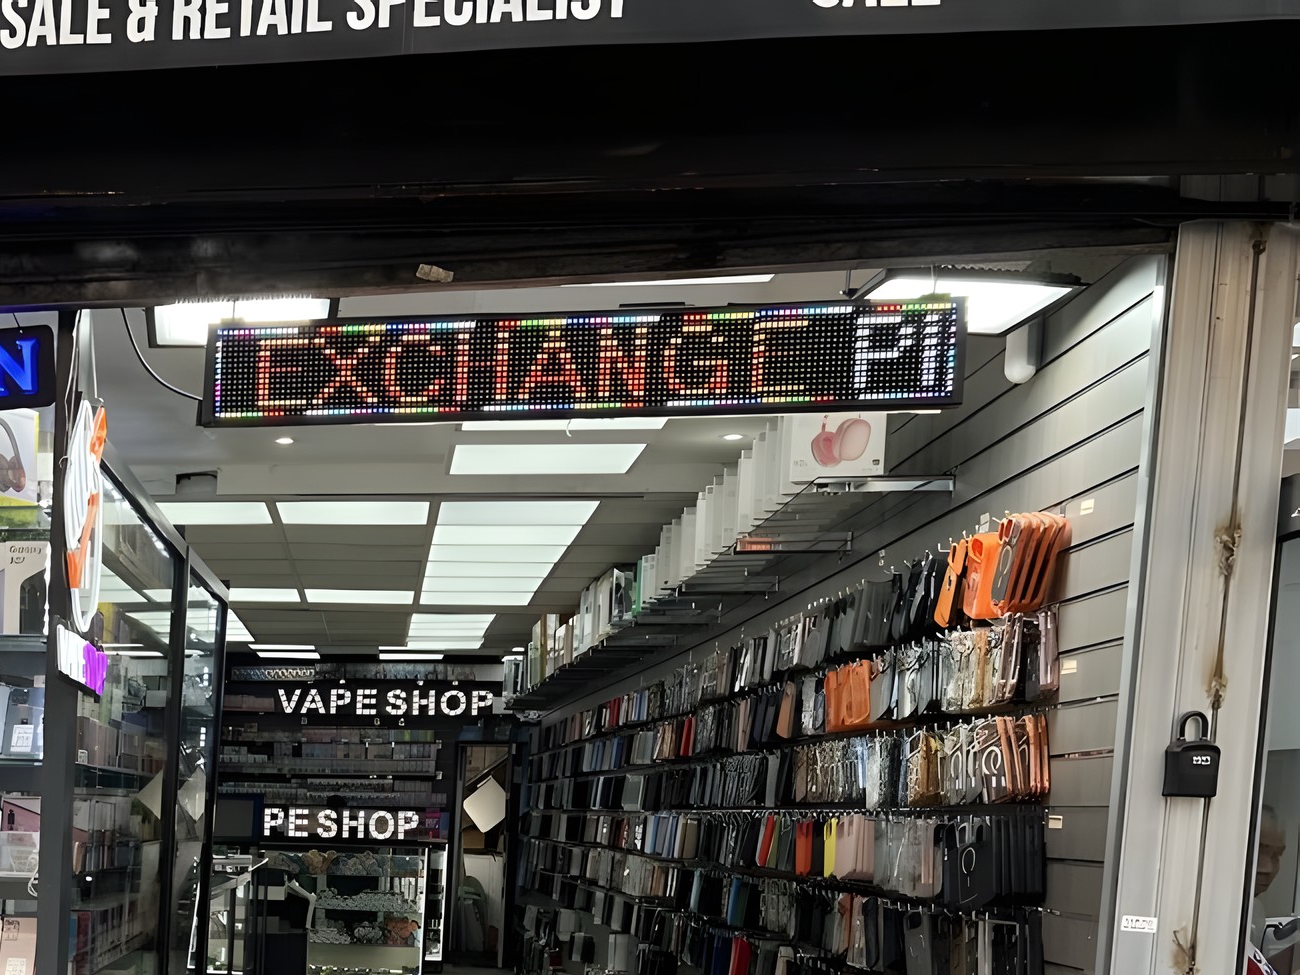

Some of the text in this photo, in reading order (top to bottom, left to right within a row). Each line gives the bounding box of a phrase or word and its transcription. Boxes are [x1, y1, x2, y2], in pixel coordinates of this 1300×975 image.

[126, 0, 158, 43] &
[172, 0, 333, 41] RETAIL
[258, 320, 809, 405] EXCHANGE
[278, 688, 493, 716] VAPE SHOP
[317, 809, 420, 839] SHOP
